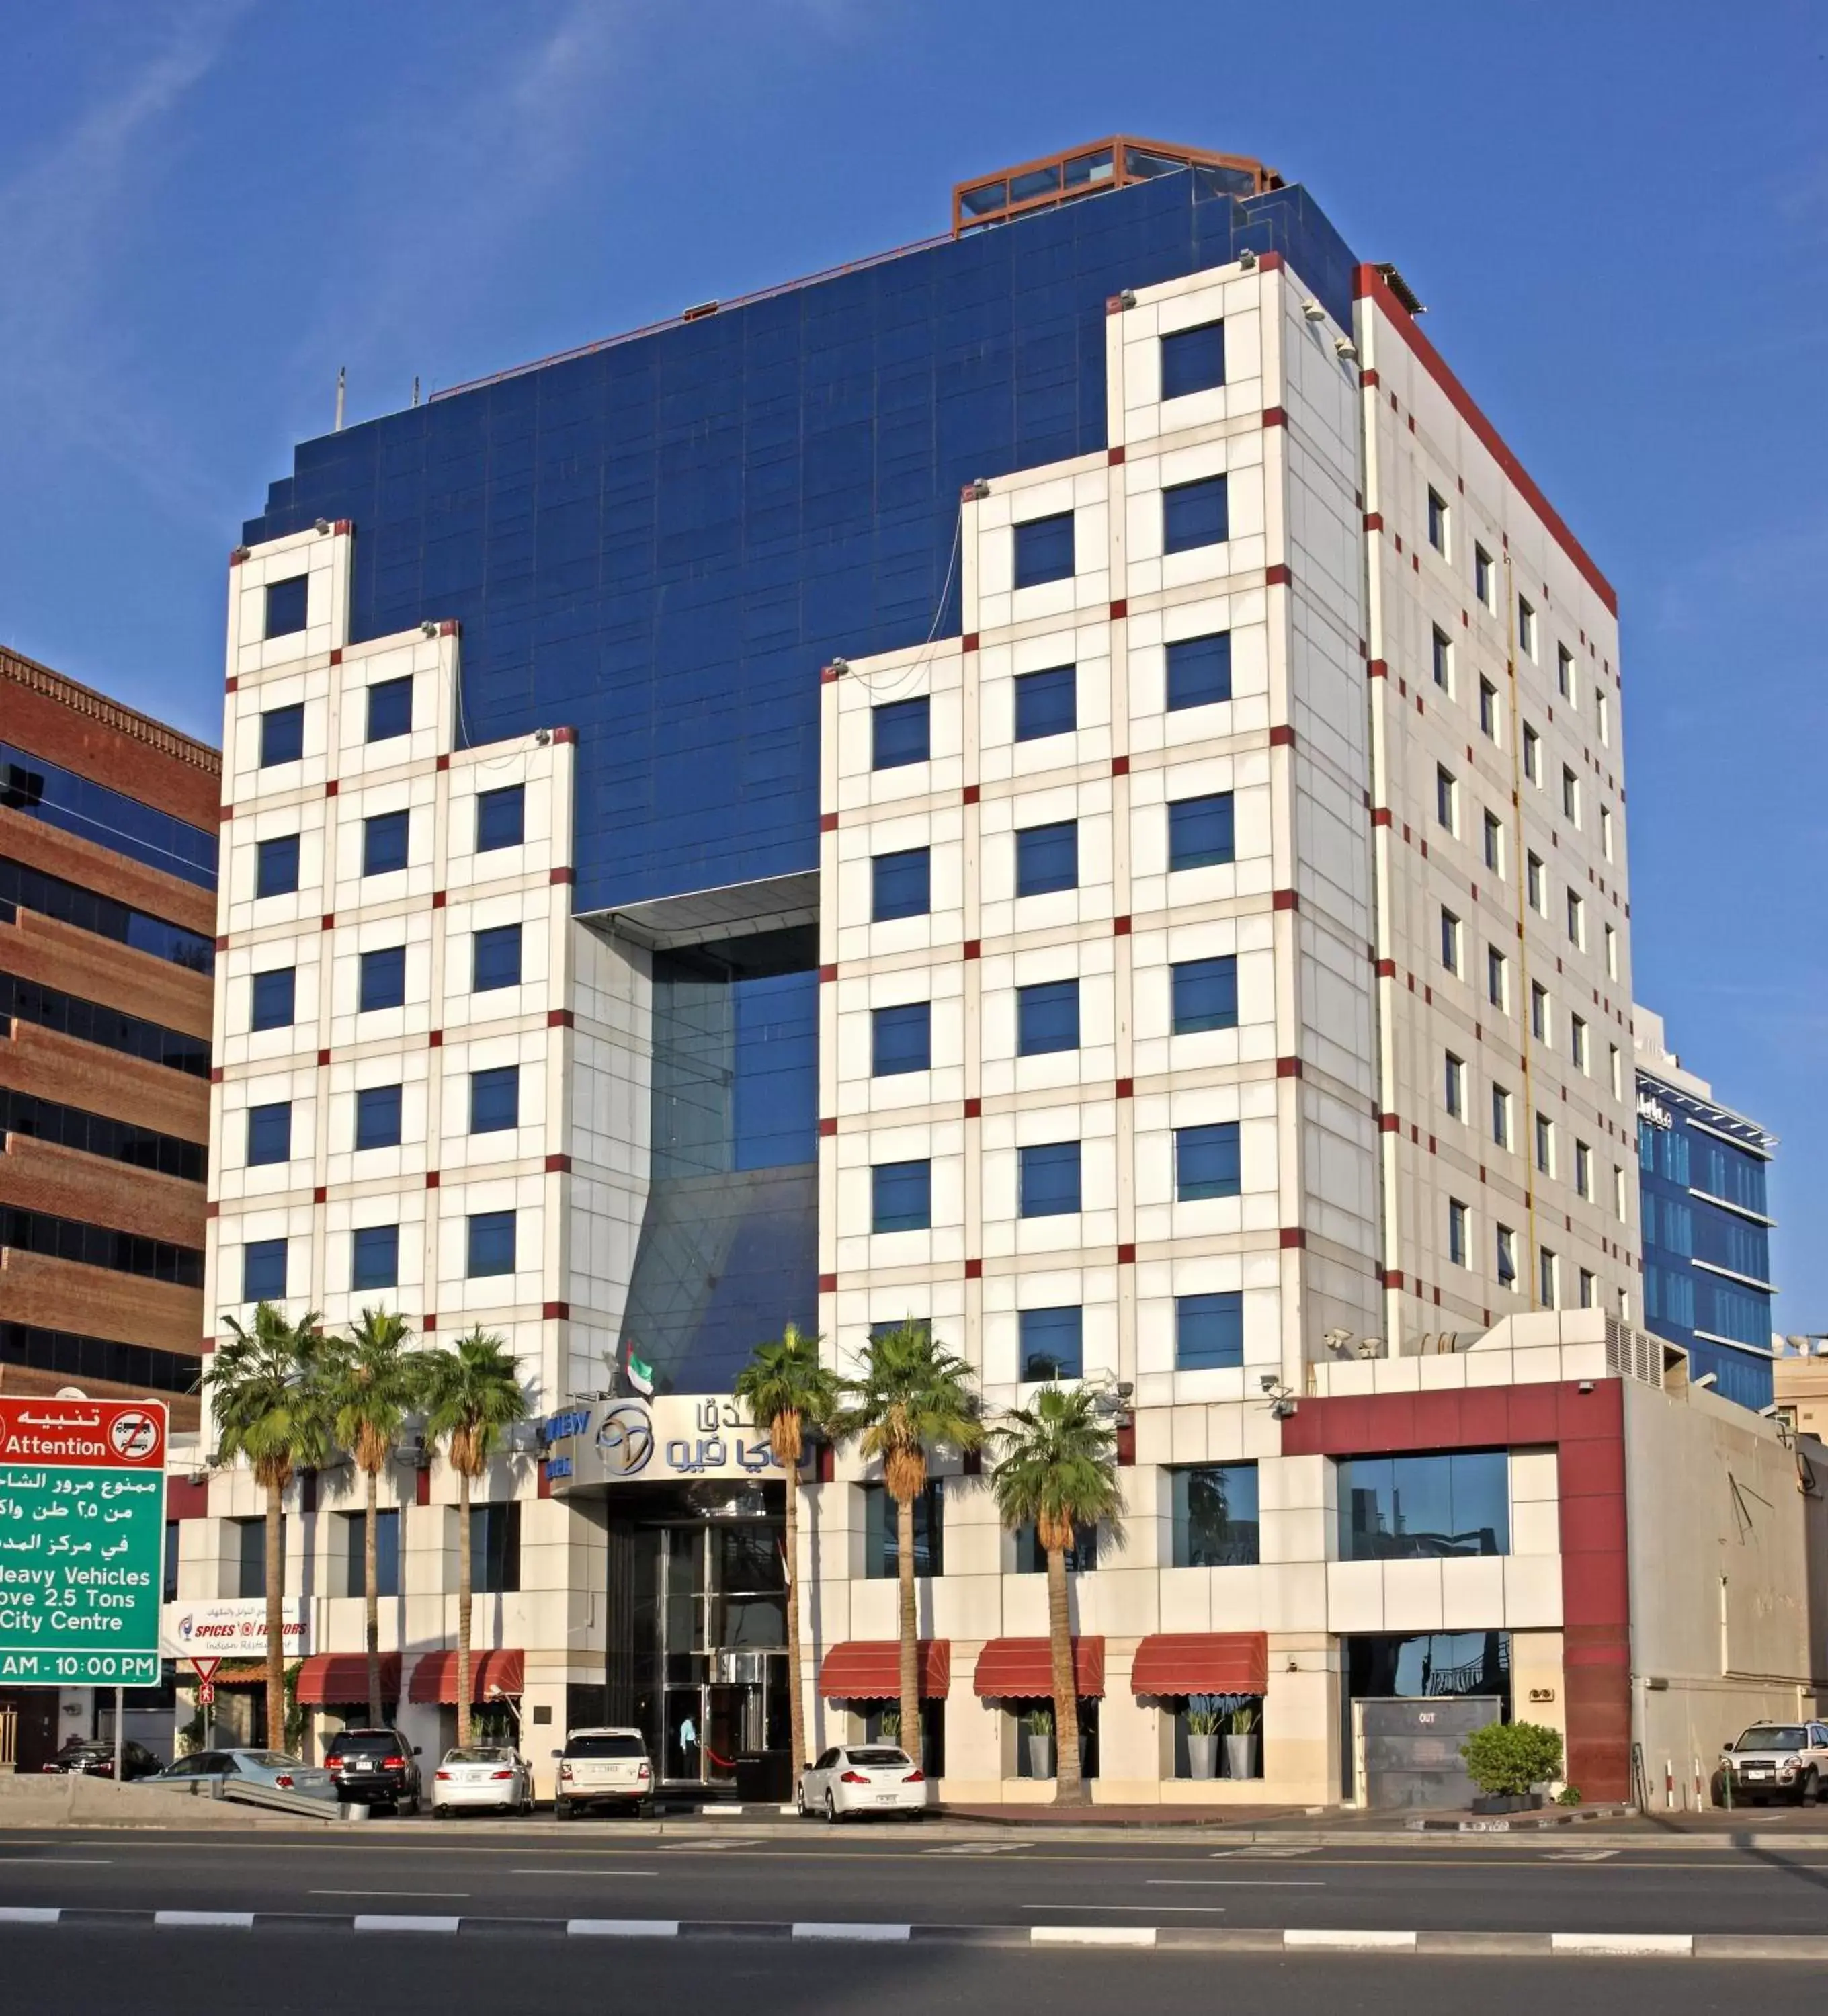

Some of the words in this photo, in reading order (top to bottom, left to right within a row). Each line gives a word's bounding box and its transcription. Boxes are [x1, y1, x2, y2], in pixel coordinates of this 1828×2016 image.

[17, 1409, 100, 1430] تنبيه
[5, 1435, 106, 1456] Attention
[52, 1480, 95, 1495] مرور
[101, 1478, 157, 1499] ممنوع
[32, 1501, 69, 1521] طن
[104, 1509, 132, 1522] من
[46, 1535, 92, 1556] مركز
[101, 1535, 128, 1560] في
[65, 1567, 150, 1585] Vehicles
[44, 1589, 77, 1607] 2.5
[86, 1589, 135, 1607] Tons
[0, 1610, 43, 1633] City
[50, 1611, 123, 1630] Centre
[195, 1624, 235, 1637] SPICES
[2, 1656, 38, 1675] AM
[56, 1656, 116, 1675] 10:00
[121, 1657, 154, 1676] PM
[1419, 1712, 1436, 1723] OUT
